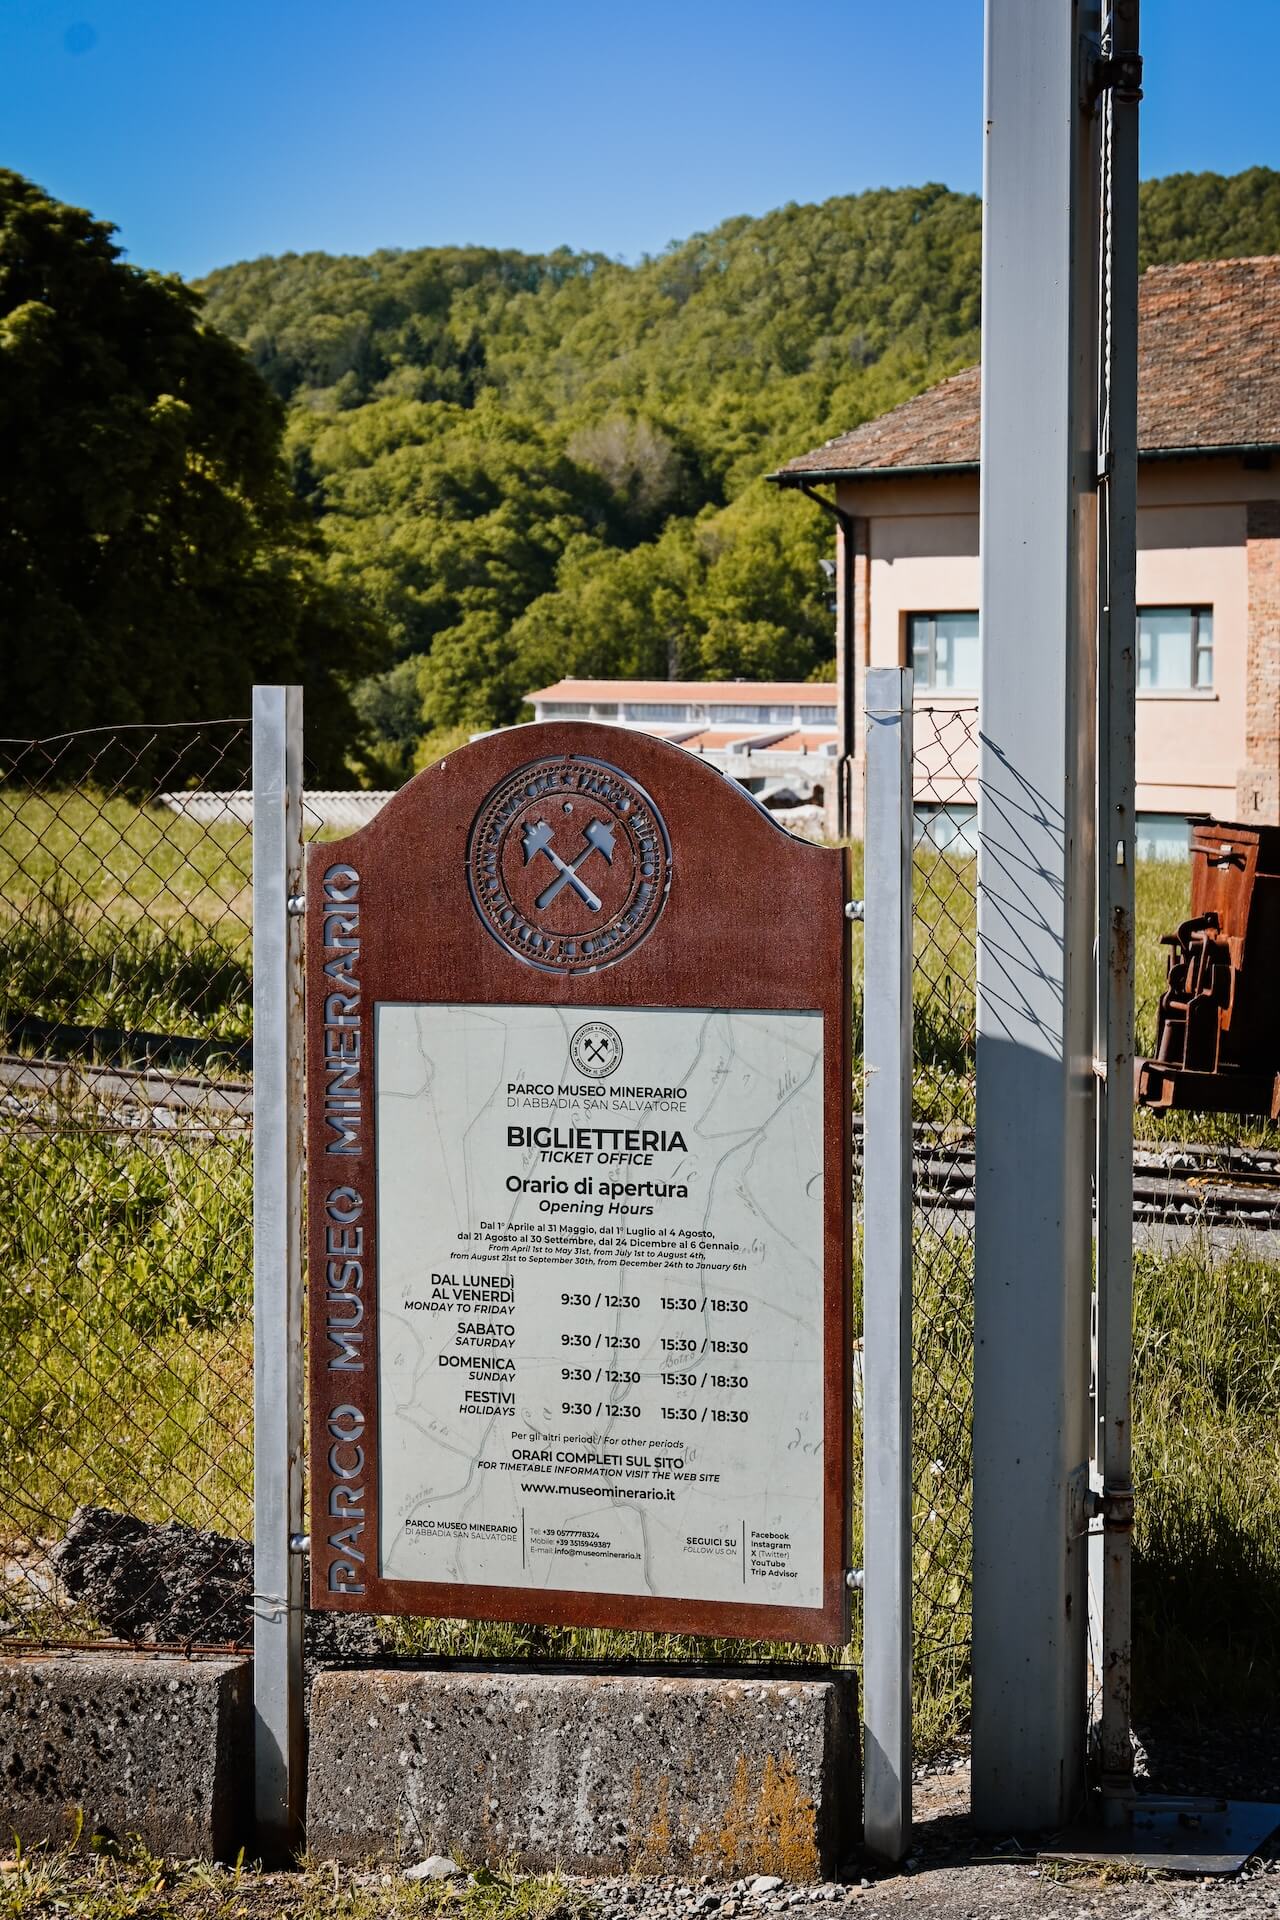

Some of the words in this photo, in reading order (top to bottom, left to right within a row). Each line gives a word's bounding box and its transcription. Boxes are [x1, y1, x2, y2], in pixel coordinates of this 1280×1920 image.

[323, 863, 362, 1155] MINERARIO
[507, 1083, 554, 1096] PARCO
[558, 1084, 606, 1097] MUSEO
[609, 1086, 688, 1099] MINERARIO
[507, 1097, 520, 1108] DI
[522, 1097, 581, 1109] ABBADIA
[583, 1098, 609, 1112] SAN
[612, 1099, 687, 1113] SALVATORE
[507, 1126, 689, 1153] BIGLIETTERIA
[539, 1150, 594, 1164] TICKET
[597, 1152, 654, 1166] OFFICE
[505, 1175, 569, 1194] Orario
[574, 1177, 593, 1195] di
[598, 1181, 688, 1200] apertura
[539, 1199, 604, 1217] Opening
[608, 1202, 654, 1216] Hours
[480, 1221, 495, 1230] Dal
[507, 1221, 535, 1233] Aprile
[537, 1223, 546, 1232] al
[547, 1224, 557, 1233] 31
[559, 1224, 597, 1237] Maggio,
[599, 1225, 614, 1235] dal
[626, 1227, 656, 1238] Luglio
[658, 1227, 667, 1237] al
[669, 1228, 676, 1237] 4
[678, 1228, 715, 1241] Agosto,
[457, 1232, 472, 1241] dal
[473, 1232, 482, 1241] 21
[484, 1233, 518, 1243] Agosto
[519, 1234, 528, 1243] al
[530, 1234, 542, 1244] 30
[544, 1235, 596, 1247] Settembre,
[598, 1237, 613, 1246] dal
[615, 1238, 628, 1247] 24
[630, 1238, 677, 1249] Dicembre
[679, 1240, 688, 1249] al
[690, 1240, 697, 1249] 6
[698, 1240, 740, 1252] Gennaio
[488, 1243, 510, 1252] From
[510, 1244, 531, 1254] April
[532, 1245, 543, 1253] 1st
[544, 1246, 554, 1254] to
[554, 1247, 573, 1256] May
[574, 1247, 592, 1256] 31st,
[593, 1247, 613, 1256] from
[614, 1248, 633, 1258] July
[634, 1249, 645, 1257] 1st
[646, 1250, 656, 1258] to
[656, 1250, 688, 1260] August
[689, 1252, 706, 1262] 4th,
[450, 1251, 470, 1260] from
[470, 1252, 500, 1262] August
[501, 1254, 517, 1262] 21st
[518, 1255, 527, 1263] to
[528, 1255, 574, 1265] September
[574, 1257, 596, 1266] 30th,
[597, 1258, 618, 1266] from
[619, 1259, 663, 1268] December
[663, 1260, 683, 1269] 24th
[695, 1261, 731, 1272] January
[732, 1263, 747, 1271] 6th
[326, 1185, 364, 1371] MUSEO
[431, 1273, 460, 1286] DAL
[463, 1274, 514, 1290] LUNEDÌ
[431, 1288, 450, 1300] AL
[452, 1288, 515, 1304] VENERDÌ
[561, 1293, 591, 1306] 9:30
[594, 1292, 602, 1308] /
[604, 1295, 641, 1309] 12:30
[404, 1301, 454, 1312] MONDAY
[456, 1303, 471, 1313] TO
[473, 1304, 516, 1315] FRIDAY
[660, 1297, 697, 1311] 15:30
[700, 1297, 708, 1313] /
[710, 1299, 748, 1313] 18:30
[457, 1322, 515, 1337] SABATO
[455, 1336, 516, 1349] SATURDAY
[561, 1334, 592, 1347] 9:30
[595, 1333, 602, 1349] /
[604, 1336, 641, 1349] 12:30
[660, 1338, 697, 1352] 15:30
[700, 1338, 708, 1354] /
[710, 1340, 748, 1354] 18:30
[438, 1354, 516, 1371] DOMENICA
[468, 1371, 516, 1383] SUNDAY
[561, 1368, 592, 1381] 9:30
[595, 1367, 602, 1383] /
[605, 1370, 641, 1384] 12:30
[660, 1373, 697, 1386] 15:30
[700, 1372, 708, 1388] /
[710, 1375, 749, 1389] 18:30
[464, 1390, 515, 1405] FESTIVI
[459, 1404, 516, 1417] HOLIDAYS
[561, 1402, 592, 1416] 9:30
[595, 1402, 603, 1417] /
[605, 1404, 641, 1418] 12:30
[660, 1407, 697, 1421] 15:30
[701, 1407, 708, 1423] /
[711, 1409, 749, 1423] 18:30
[511, 1431, 527, 1440] Per
[529, 1432, 540, 1442] gli
[543, 1433, 561, 1442] altri
[563, 1435, 596, 1444] periodi
[598, 1435, 602, 1445] /
[604, 1437, 619, 1445] For
[621, 1438, 647, 1447] other
[649, 1440, 684, 1449] periods
[511, 1449, 553, 1462] ORARI
[556, 1451, 623, 1466] COMPLETI
[625, 1455, 652, 1468] SUL
[654, 1456, 686, 1471] SITO
[477, 1460, 498, 1470] FOR
[499, 1462, 553, 1473] TIMETABLE
[554, 1465, 623, 1478] INFORMATION
[625, 1469, 650, 1479] VISIT
[651, 1469, 671, 1480] THE
[673, 1472, 697, 1482] WEB
[698, 1473, 721, 1483] SITE
[327, 1403, 366, 1595] PARCO
[520, 1483, 676, 1501] www.museominerario.it
[405, 1519, 436, 1529] PARCO
[437, 1521, 468, 1531] MUSEO
[469, 1523, 518, 1534] MINERARIO
[686, 1537, 722, 1547] SEGUICI
[724, 1539, 737, 1547] SU
[751, 1531, 790, 1540] Facebook
[751, 1540, 792, 1550] Instagram
[750, 1559, 786, 1568] YouTube
[750, 1568, 767, 1577] Trip
[767, 1569, 798, 1579] Advisor
